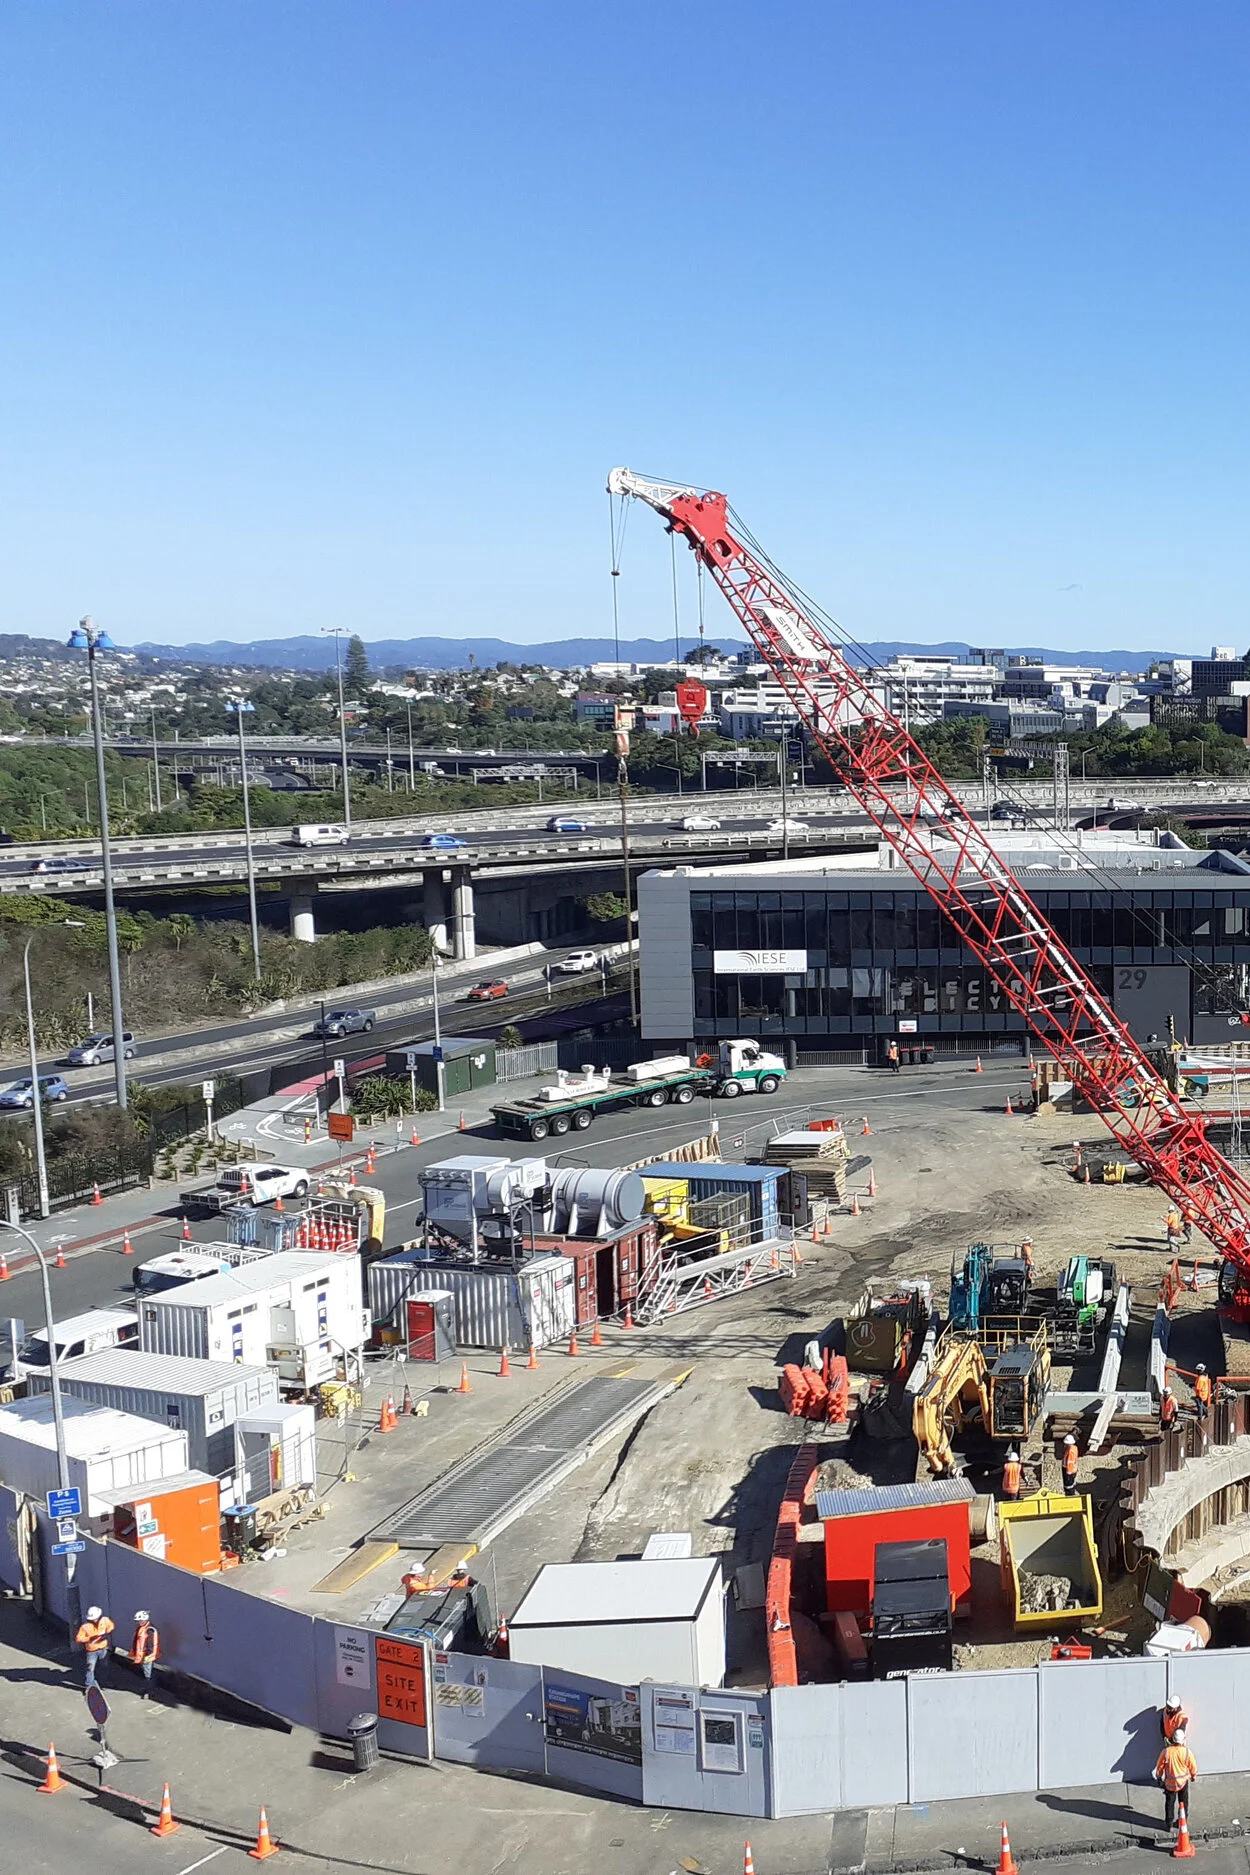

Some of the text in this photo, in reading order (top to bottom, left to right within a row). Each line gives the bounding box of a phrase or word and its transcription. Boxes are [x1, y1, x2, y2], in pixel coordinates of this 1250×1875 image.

[776, 616, 806, 651] SMITH
[757, 952, 787, 964] IESE
[1118, 968, 1148, 990] 29
[339, 1642, 366, 1654] PARKING
[346, 1637, 357, 1645] NO
[379, 1643, 403, 1658] GATE
[412, 1651, 419, 1662] 2
[385, 1673, 416, 1691] SITE
[385, 1694, 418, 1712] EXIT
